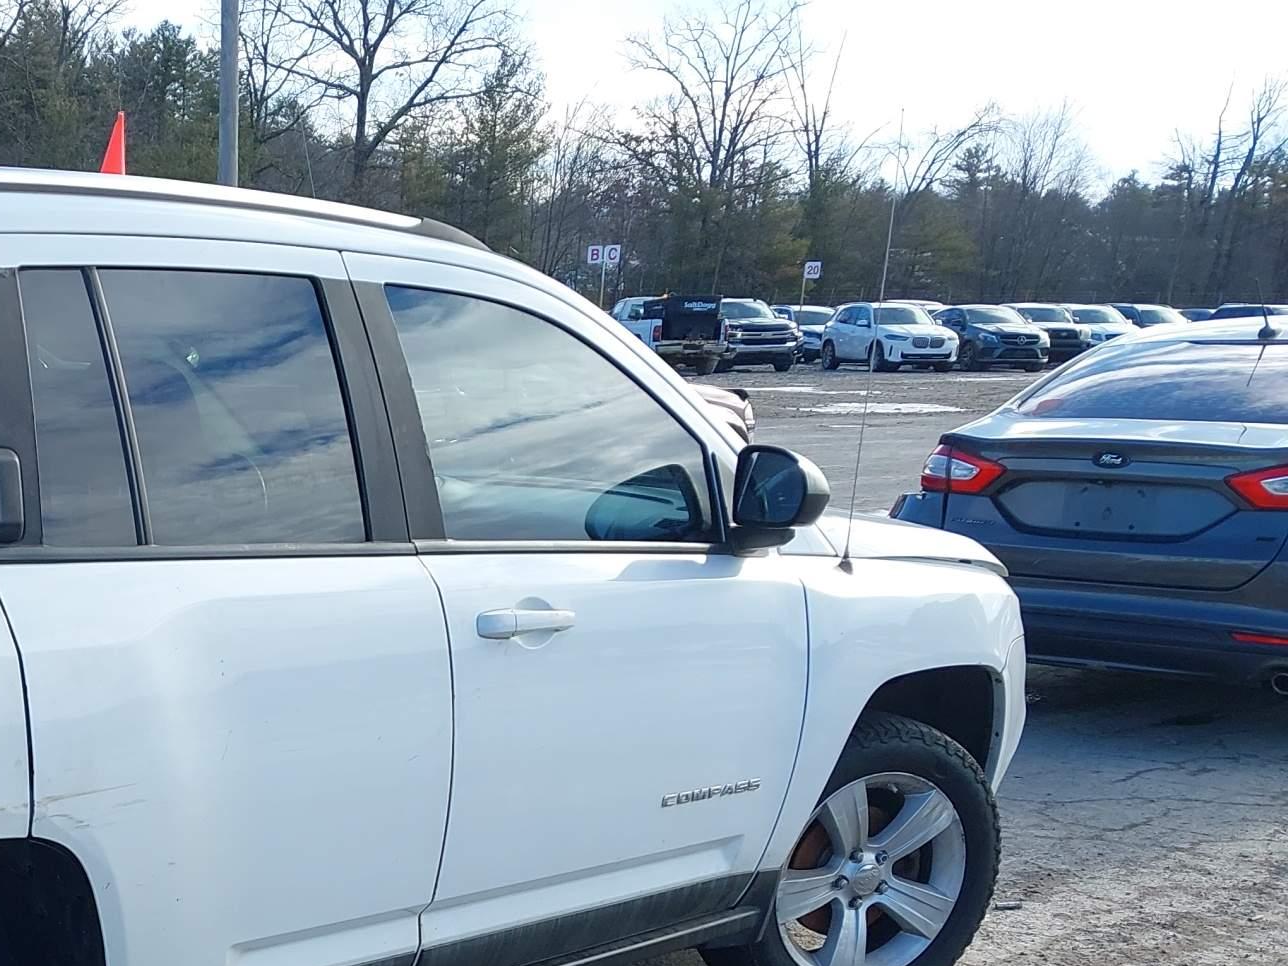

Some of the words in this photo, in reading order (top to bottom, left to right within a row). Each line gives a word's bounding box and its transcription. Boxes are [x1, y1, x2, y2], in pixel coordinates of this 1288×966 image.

[591, 248, 600, 261] B
[608, 247, 618, 260] C
[807, 265, 819, 275] 20
[661, 778, 761, 808] COMPASS
